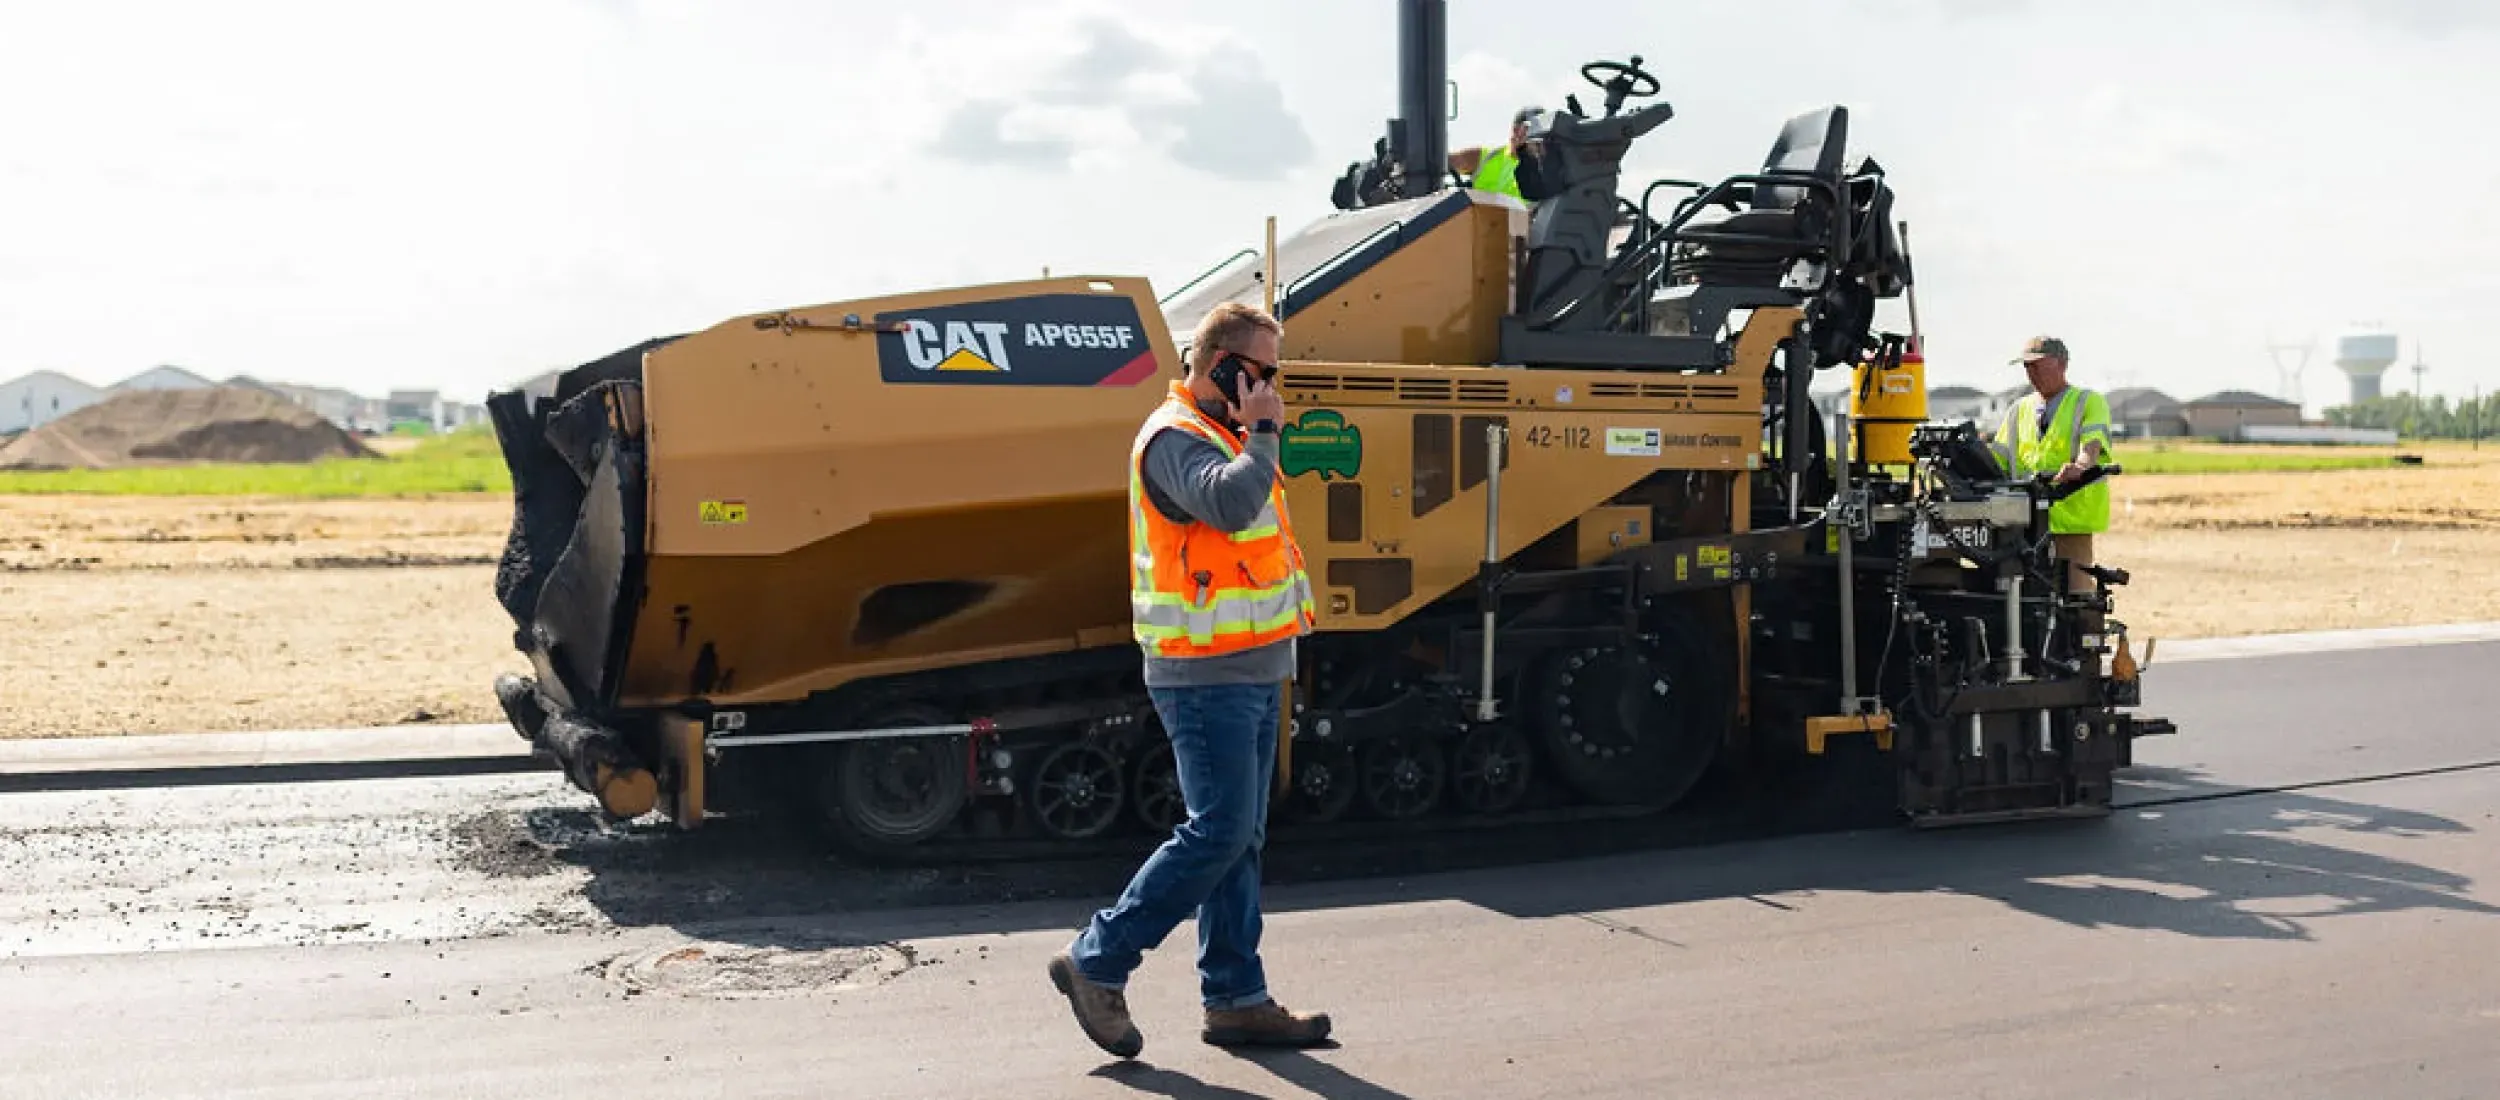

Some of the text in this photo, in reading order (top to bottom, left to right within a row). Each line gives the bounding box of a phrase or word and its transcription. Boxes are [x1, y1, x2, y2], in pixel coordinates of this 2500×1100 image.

[902, 319, 1133, 371] CAT AP655F
[1526, 425, 1591, 448] 42-112
